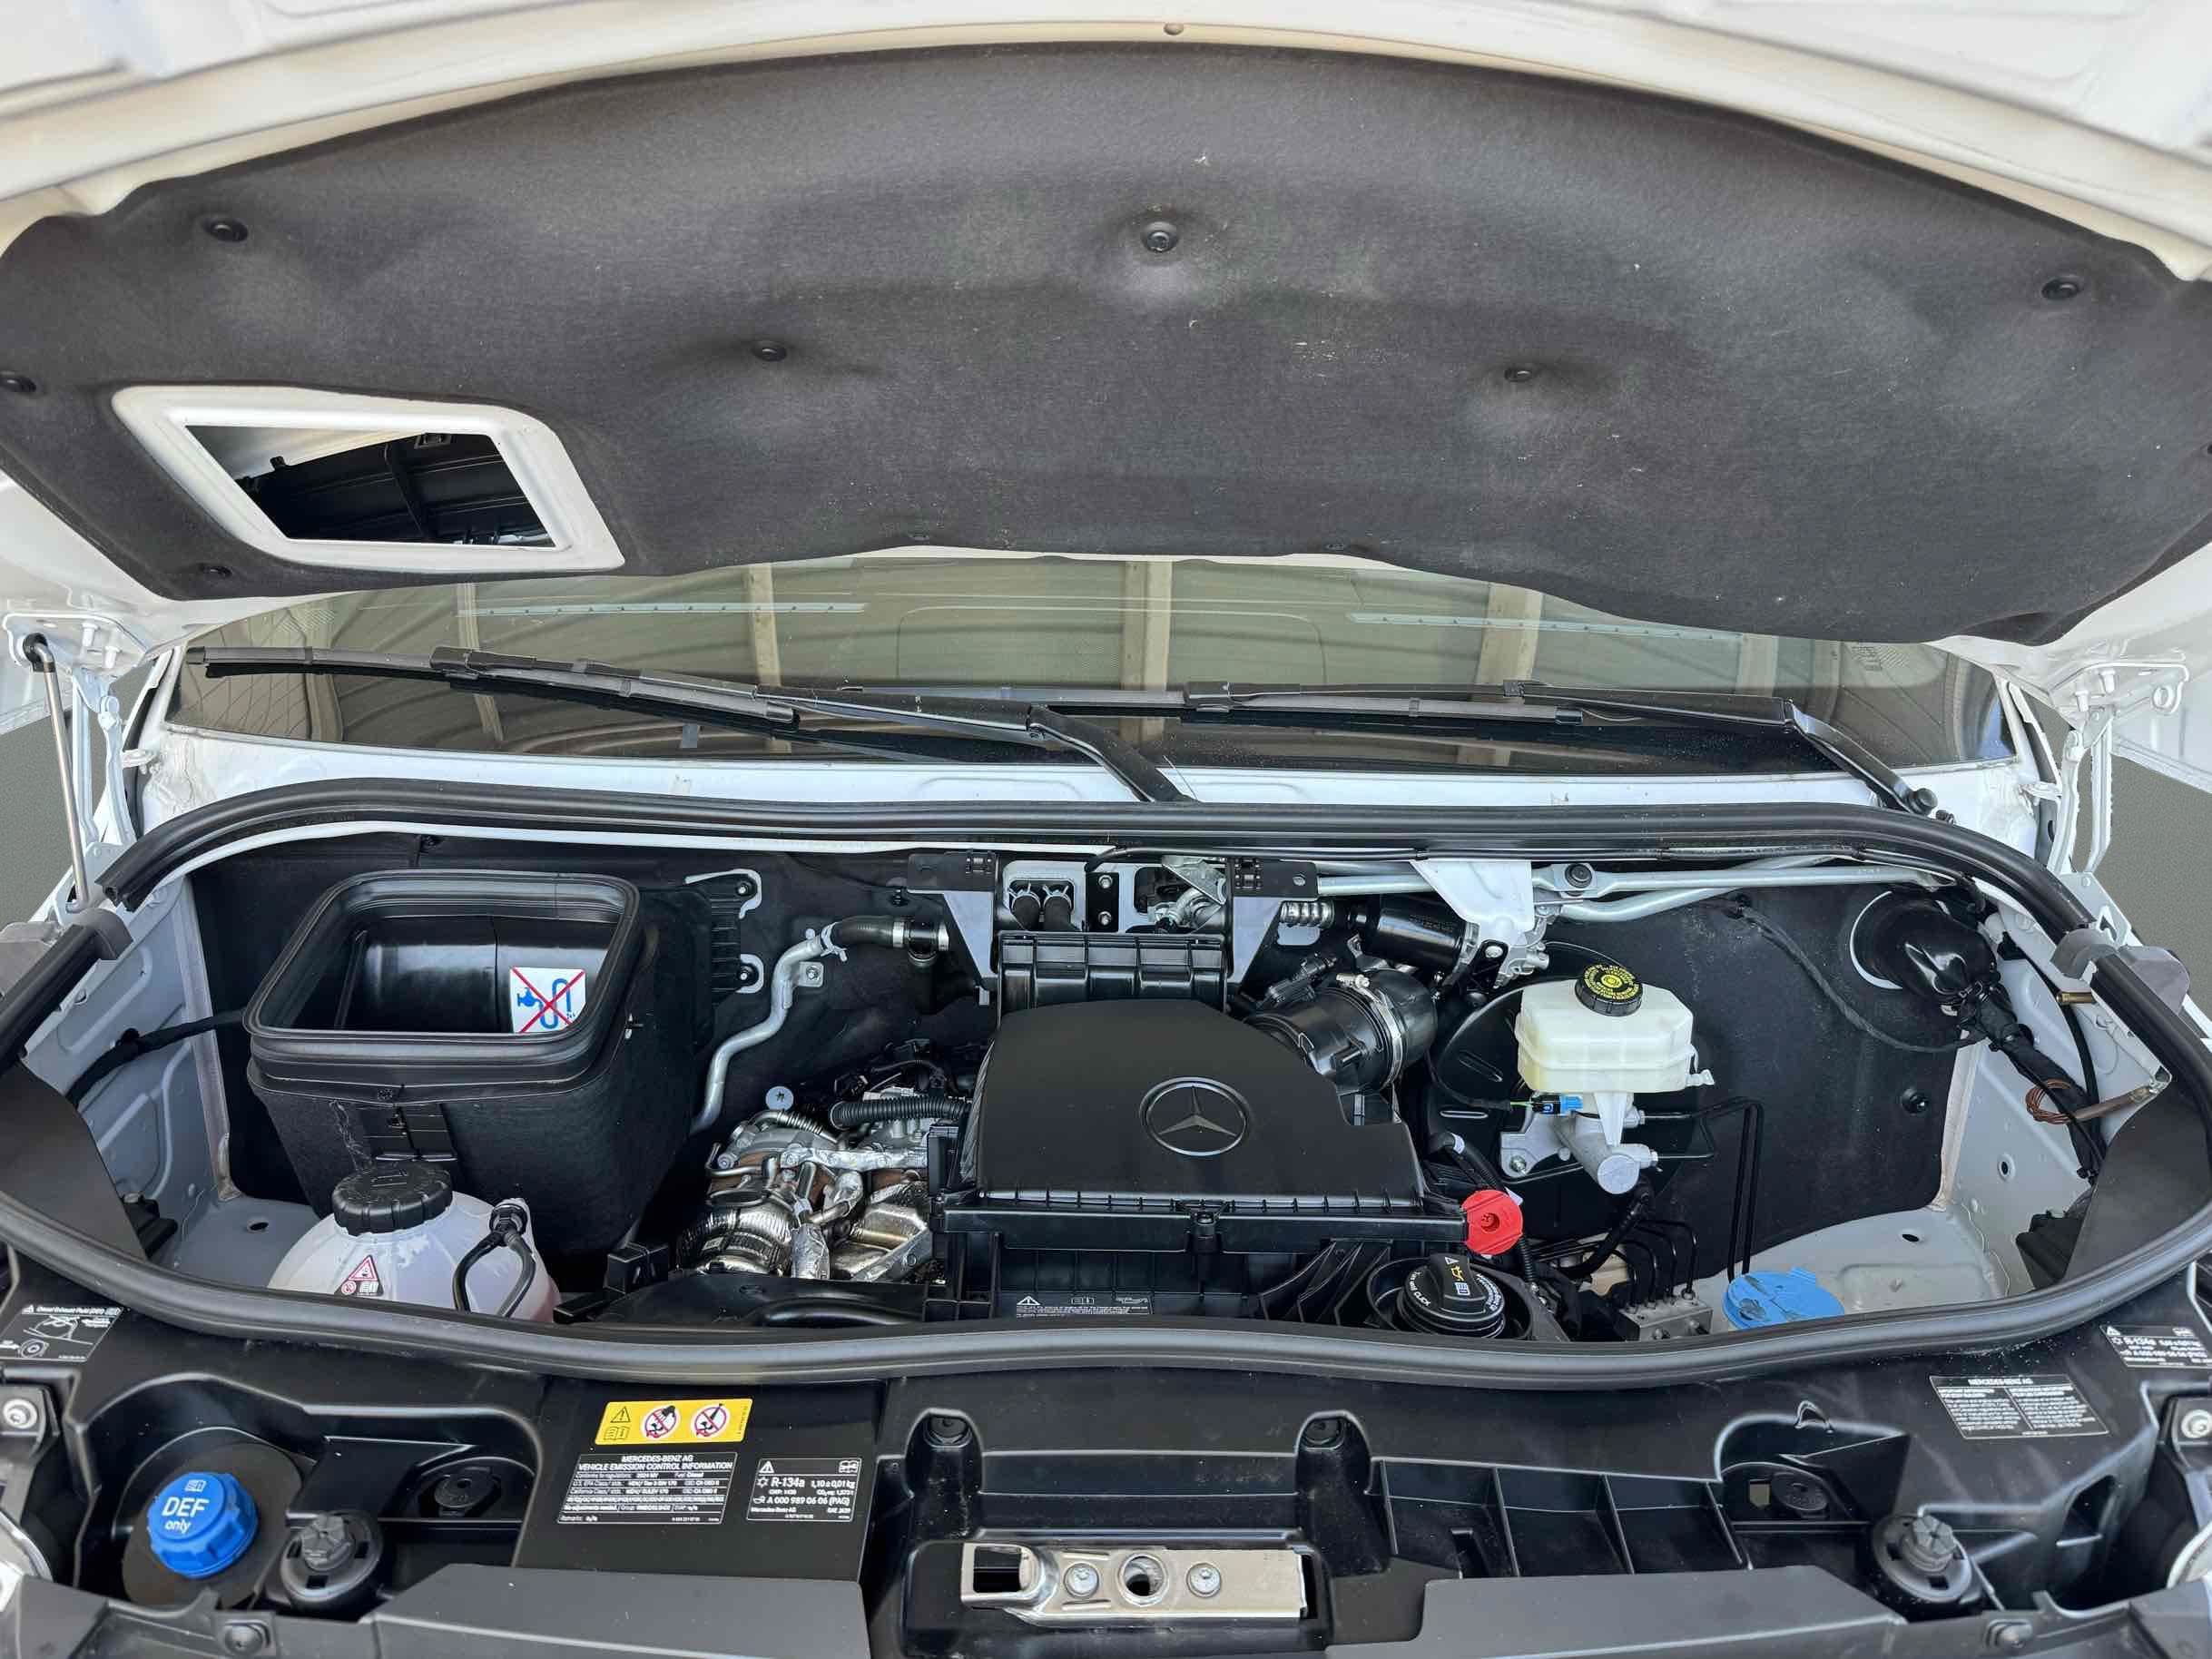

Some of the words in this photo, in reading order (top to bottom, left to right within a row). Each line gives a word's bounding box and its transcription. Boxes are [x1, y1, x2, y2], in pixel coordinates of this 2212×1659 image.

[1413, 1291, 1431, 1307] CLICK
[621, 1455, 682, 1463] MERCEDES-BENZ
[578, 1463, 609, 1471] VEHICLE
[609, 1463, 645, 1471] EMISSION
[645, 1462, 681, 1470] CONTROL
[681, 1461, 733, 1470] INFORMATION
[771, 1477, 806, 1488] R-134a
[162, 1496, 210, 1517] DEF
[774, 1497, 790, 1505] 000
[790, 1497, 806, 1505] 989
[829, 1497, 850, 1507] (PAG)
[165, 1519, 192, 1534] only
